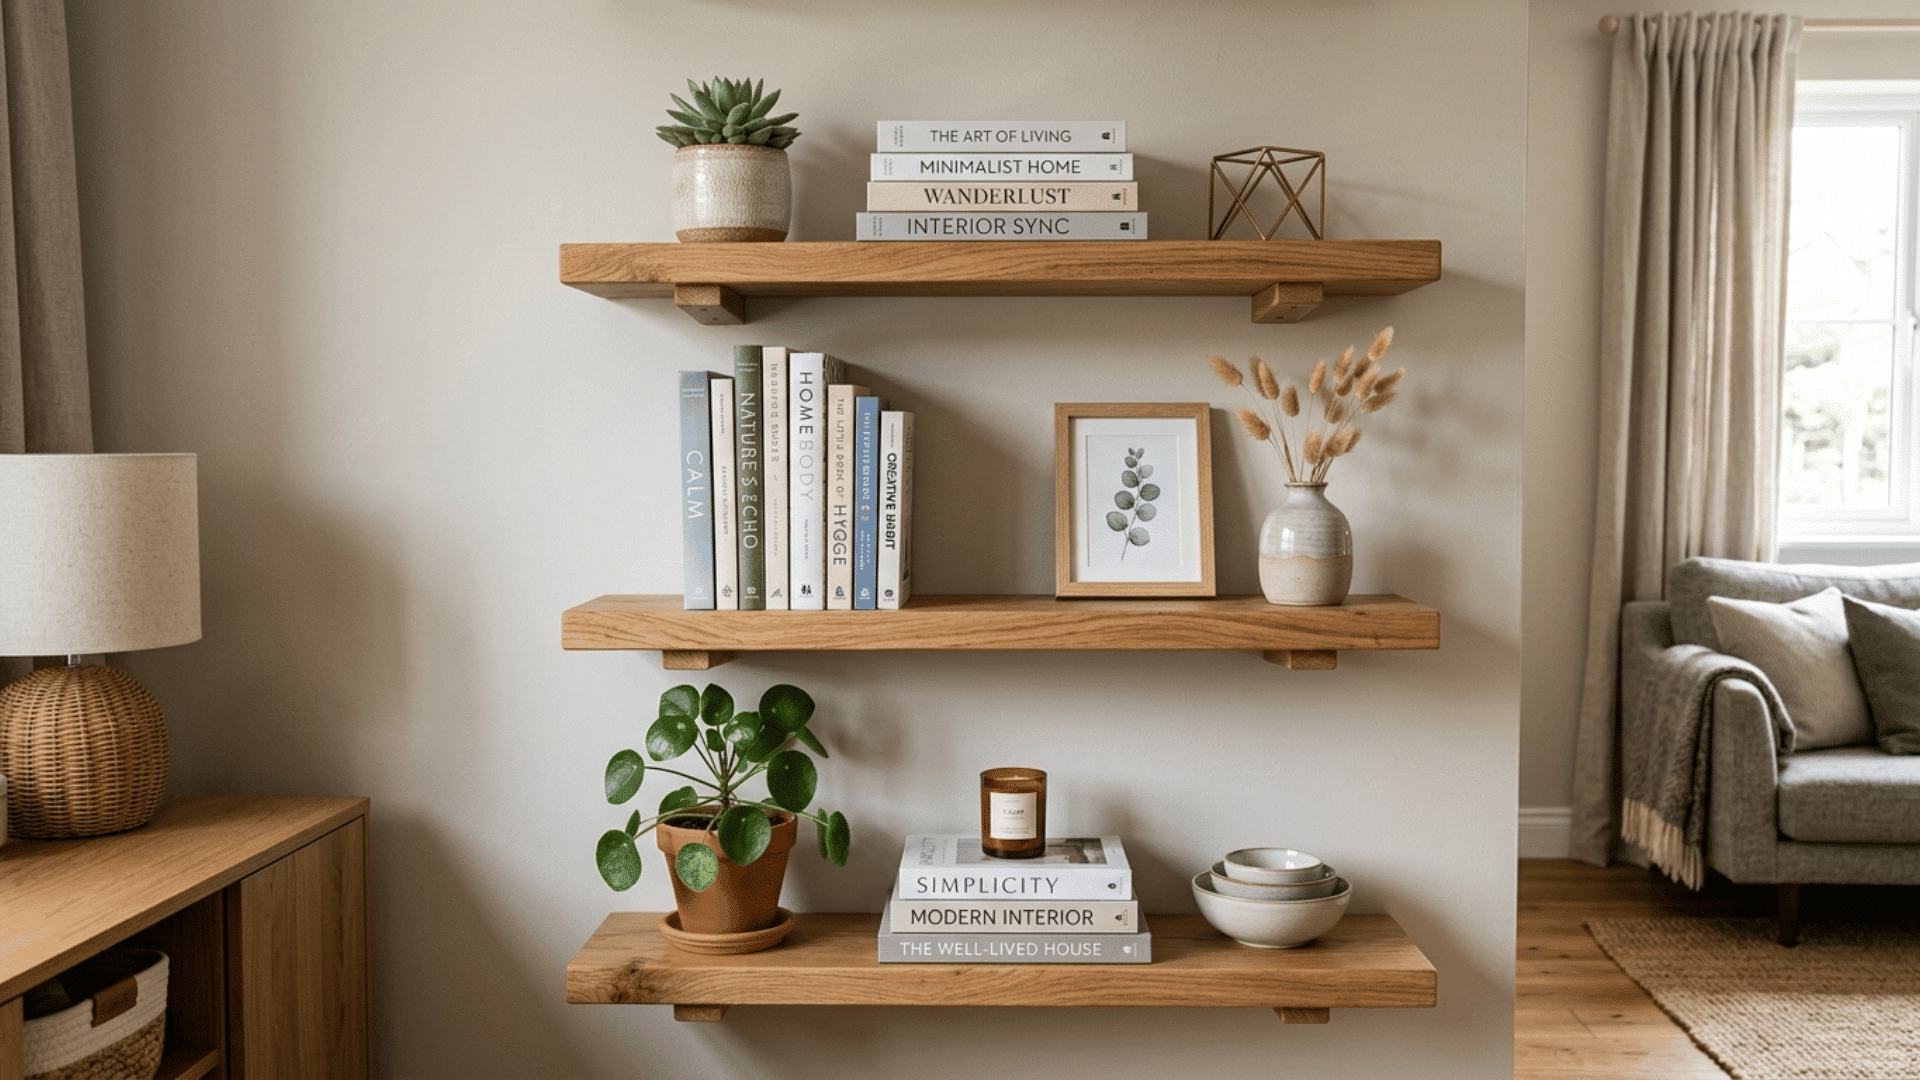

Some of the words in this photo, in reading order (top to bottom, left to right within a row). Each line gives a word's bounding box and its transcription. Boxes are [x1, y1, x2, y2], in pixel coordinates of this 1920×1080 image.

[930, 129, 959, 143] THE
[963, 129, 991, 143] ART
[995, 129, 1017, 143] OF
[1021, 129, 1072, 143] LIVING
[920, 160, 1022, 174] MINIMALIST
[1028, 160, 1081, 174] HOME
[924, 188, 1071, 205] WANDERLUST
[907, 218, 1006, 234] INTERIOR
[1012, 218, 1070, 235] SYNC
[799, 371, 814, 501] HOMEBODY
[686, 450, 705, 520] CALM
[886, 452, 898, 510] CREATIVE
[742, 494, 758, 549] ECHO
[833, 504, 847, 565] HYGGE
[885, 514, 896, 550] HABIT
[917, 877, 1059, 894] SIMPLICITY
[911, 909, 995, 925] MODERN
[1003, 909, 1094, 925] INTERIOR
[899, 941, 932, 956] THE
[938, 941, 1038, 956] WELL-LIVED
[1044, 941, 1101, 956] HOUSE
